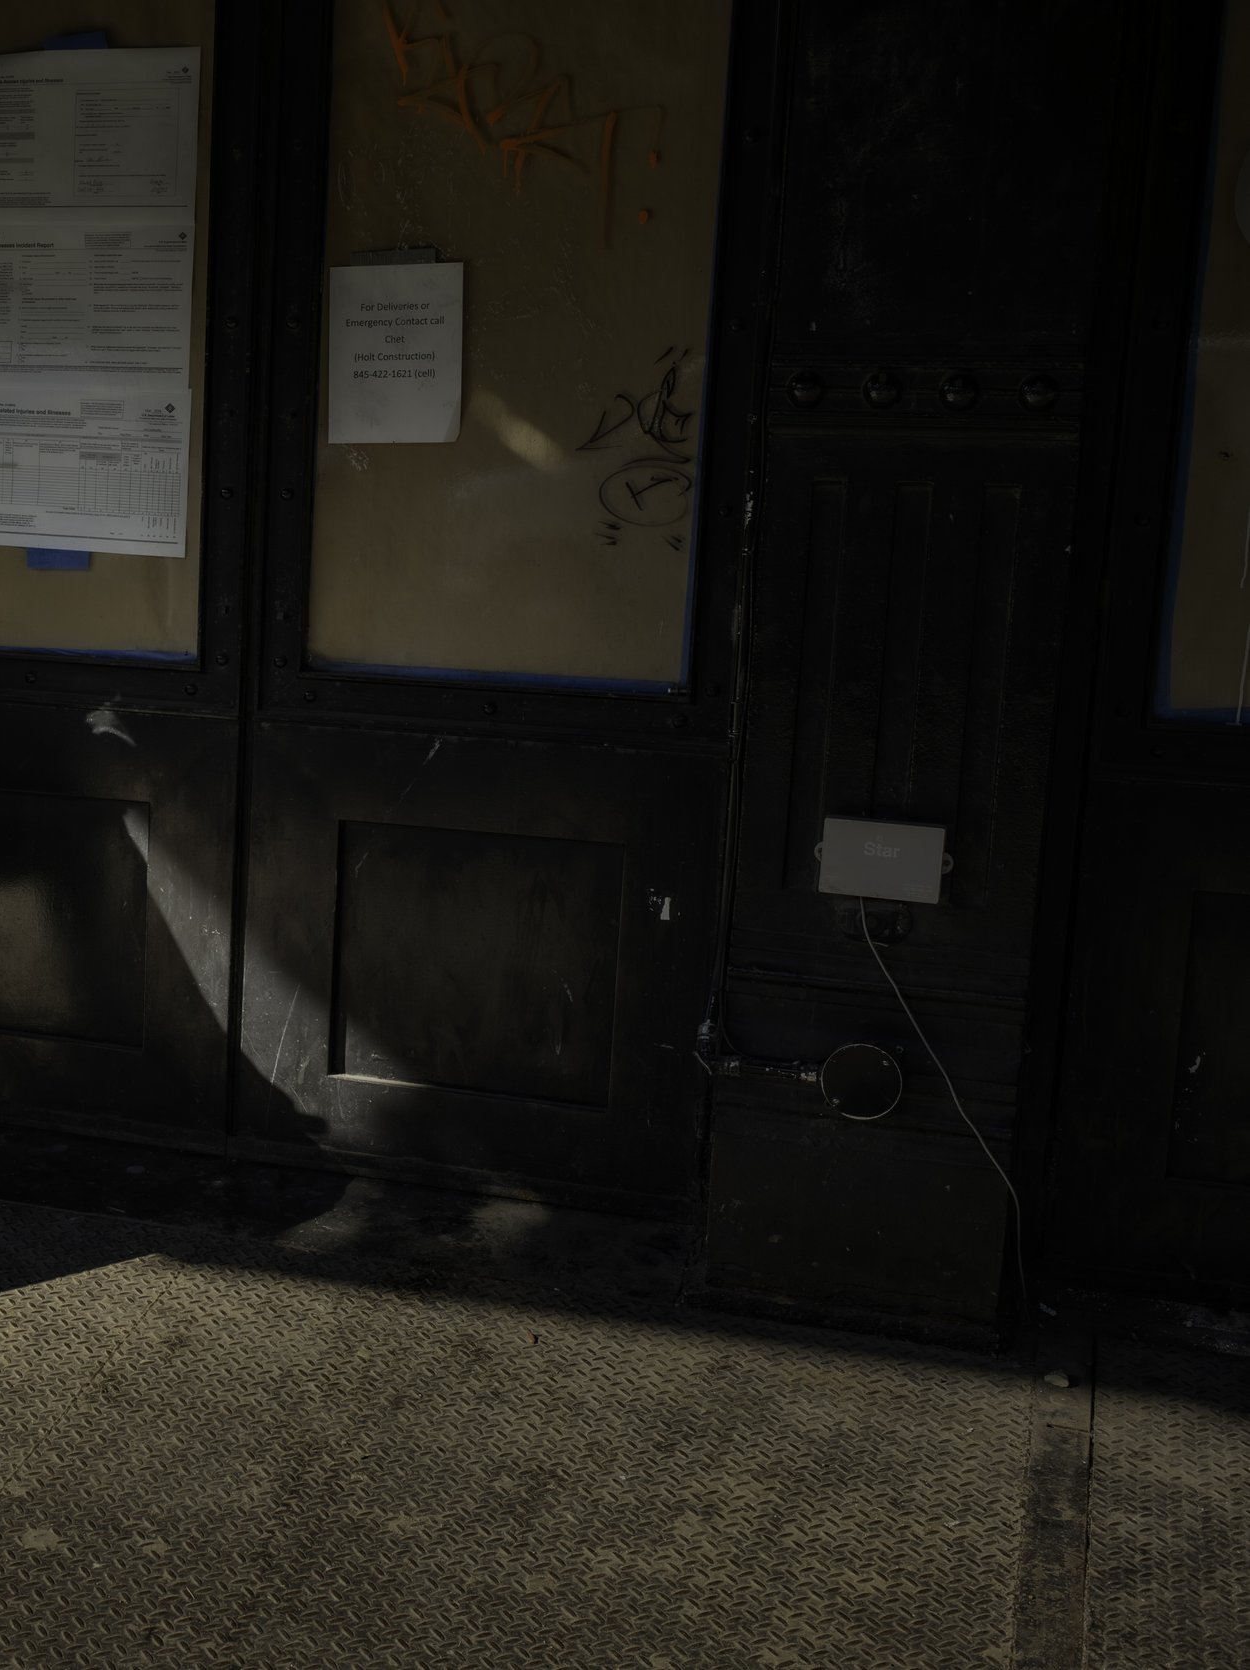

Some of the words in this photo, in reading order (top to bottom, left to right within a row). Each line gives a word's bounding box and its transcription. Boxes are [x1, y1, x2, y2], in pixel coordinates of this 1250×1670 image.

[37, 242, 54, 250] Report
[360, 303, 375, 312] For
[377, 302, 419, 311] Deliveries
[345, 318, 393, 329] Emergency
[395, 317, 429, 326] Contact
[430, 316, 445, 325] call
[384, 335, 405, 344] Chet
[354, 352, 375, 363] (Holt
[377, 351, 436, 363] Construction)
[353, 369, 413, 380] 845-422-1621
[414, 368, 436, 380] (cell)
[15, 408, 35, 416] Injuries
[862, 841, 901, 859] Star
